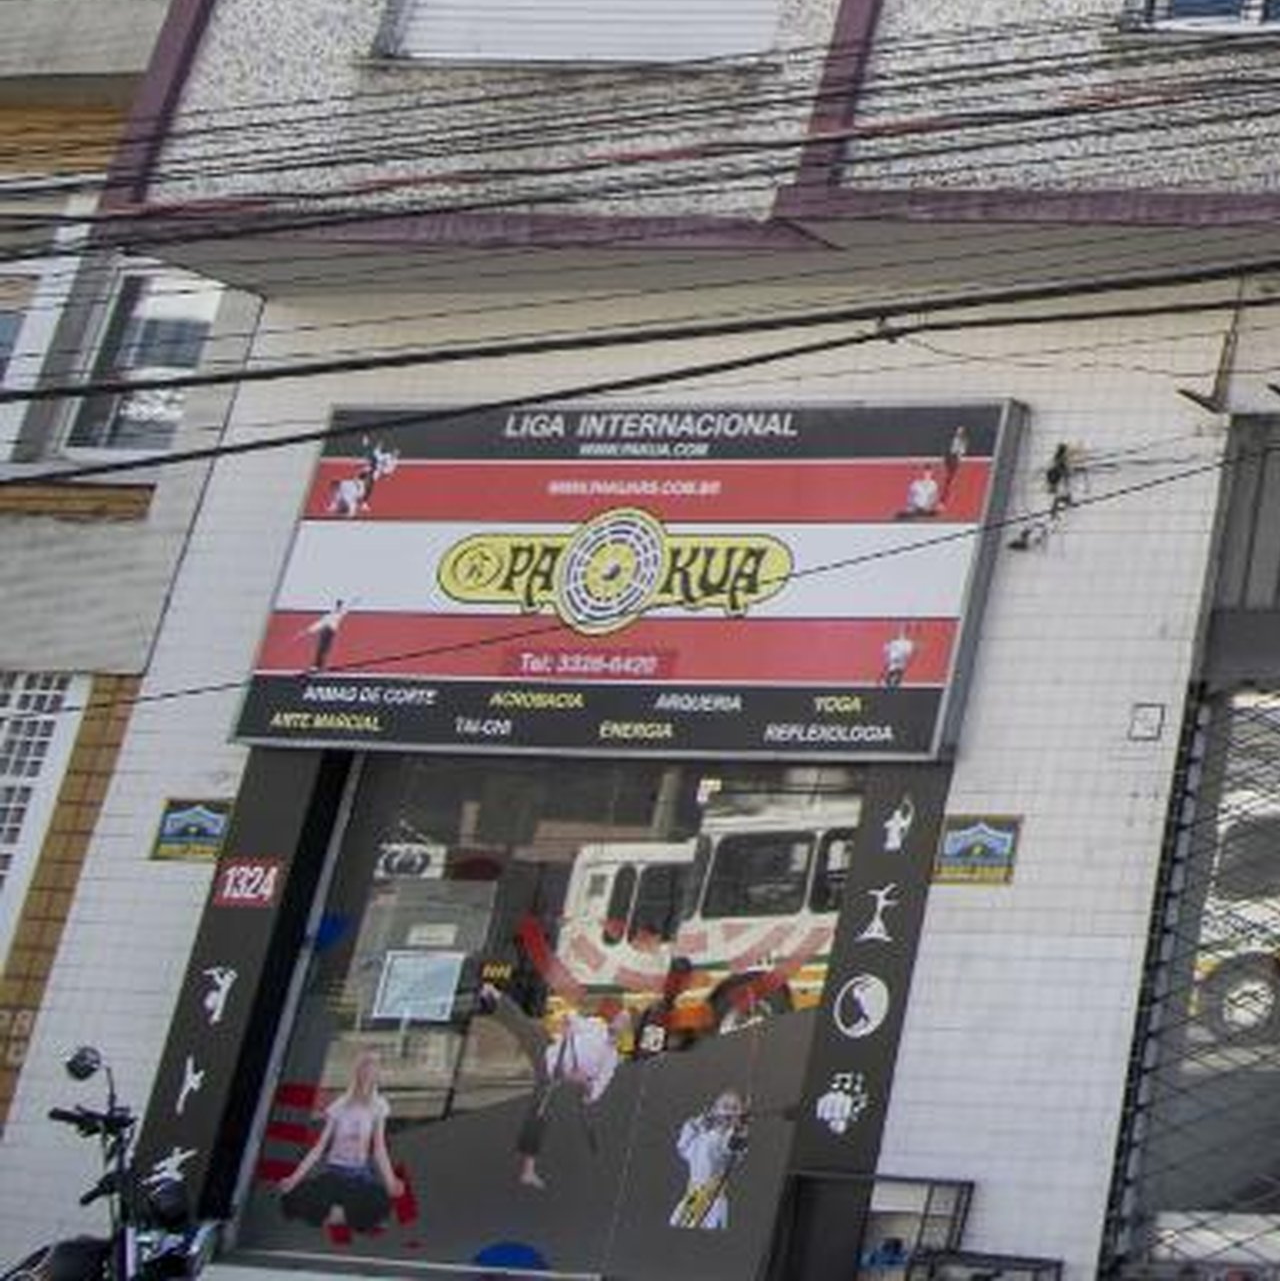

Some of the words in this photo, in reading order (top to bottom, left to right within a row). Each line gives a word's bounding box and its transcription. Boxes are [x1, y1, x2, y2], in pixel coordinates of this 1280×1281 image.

[505, 414, 565, 437] LIGA
[576, 412, 797, 437] INTERNACIONAL
[358, 686, 381, 703] DE
[383, 688, 438, 706] CORTE
[490, 692, 584, 708] ACROBACIA
[654, 693, 742, 712] ARQUERIA
[814, 696, 862, 713] YOGA
[599, 721, 674, 739] ENERGIA
[763, 723, 894, 742] REFLEXOLOGIA
[222, 866, 279, 900] 1324
